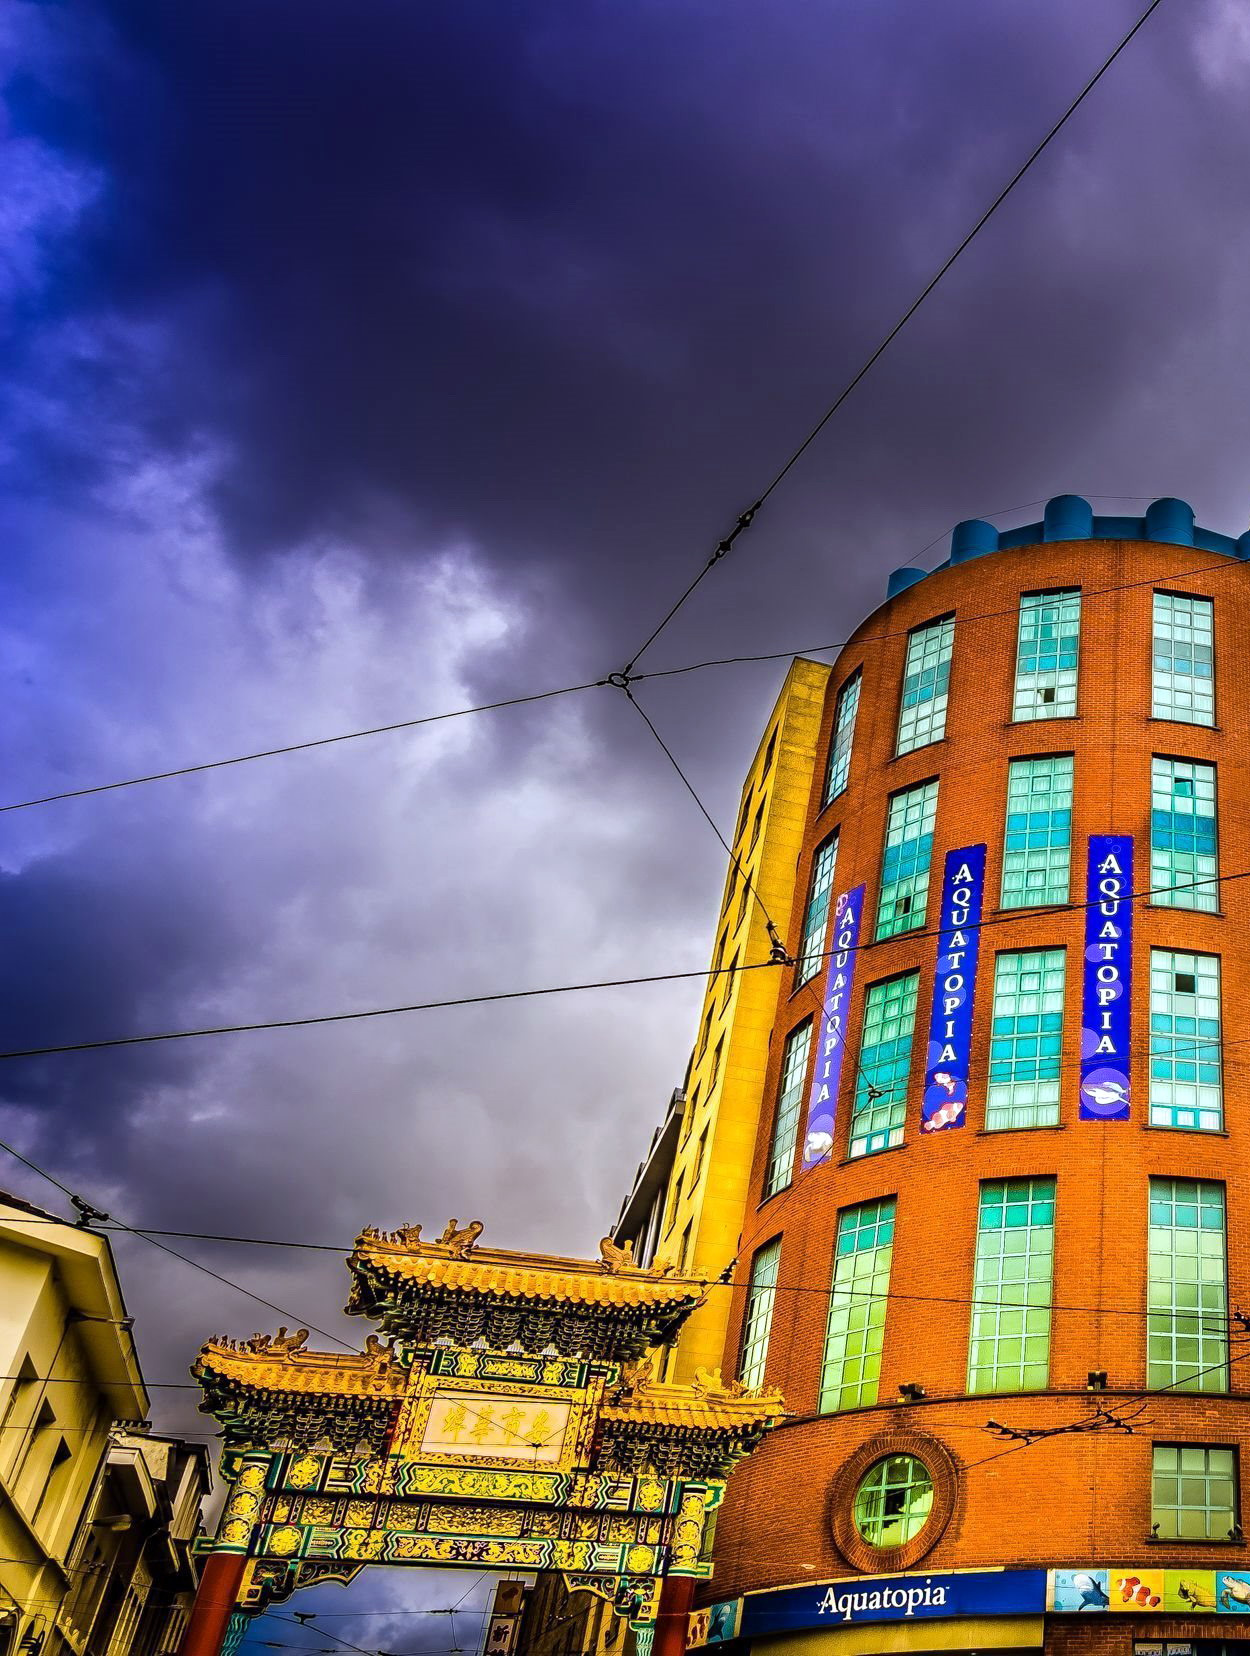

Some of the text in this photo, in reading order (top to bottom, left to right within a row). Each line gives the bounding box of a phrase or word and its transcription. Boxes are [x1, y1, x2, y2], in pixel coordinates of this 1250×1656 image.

[816, 906, 855, 1103] AQUATOPIA
[938, 863, 974, 1063] AQUATOPIA
[1095, 853, 1122, 1055] AQUATOPIA
[817, 1578, 947, 1621] Aquatopia
